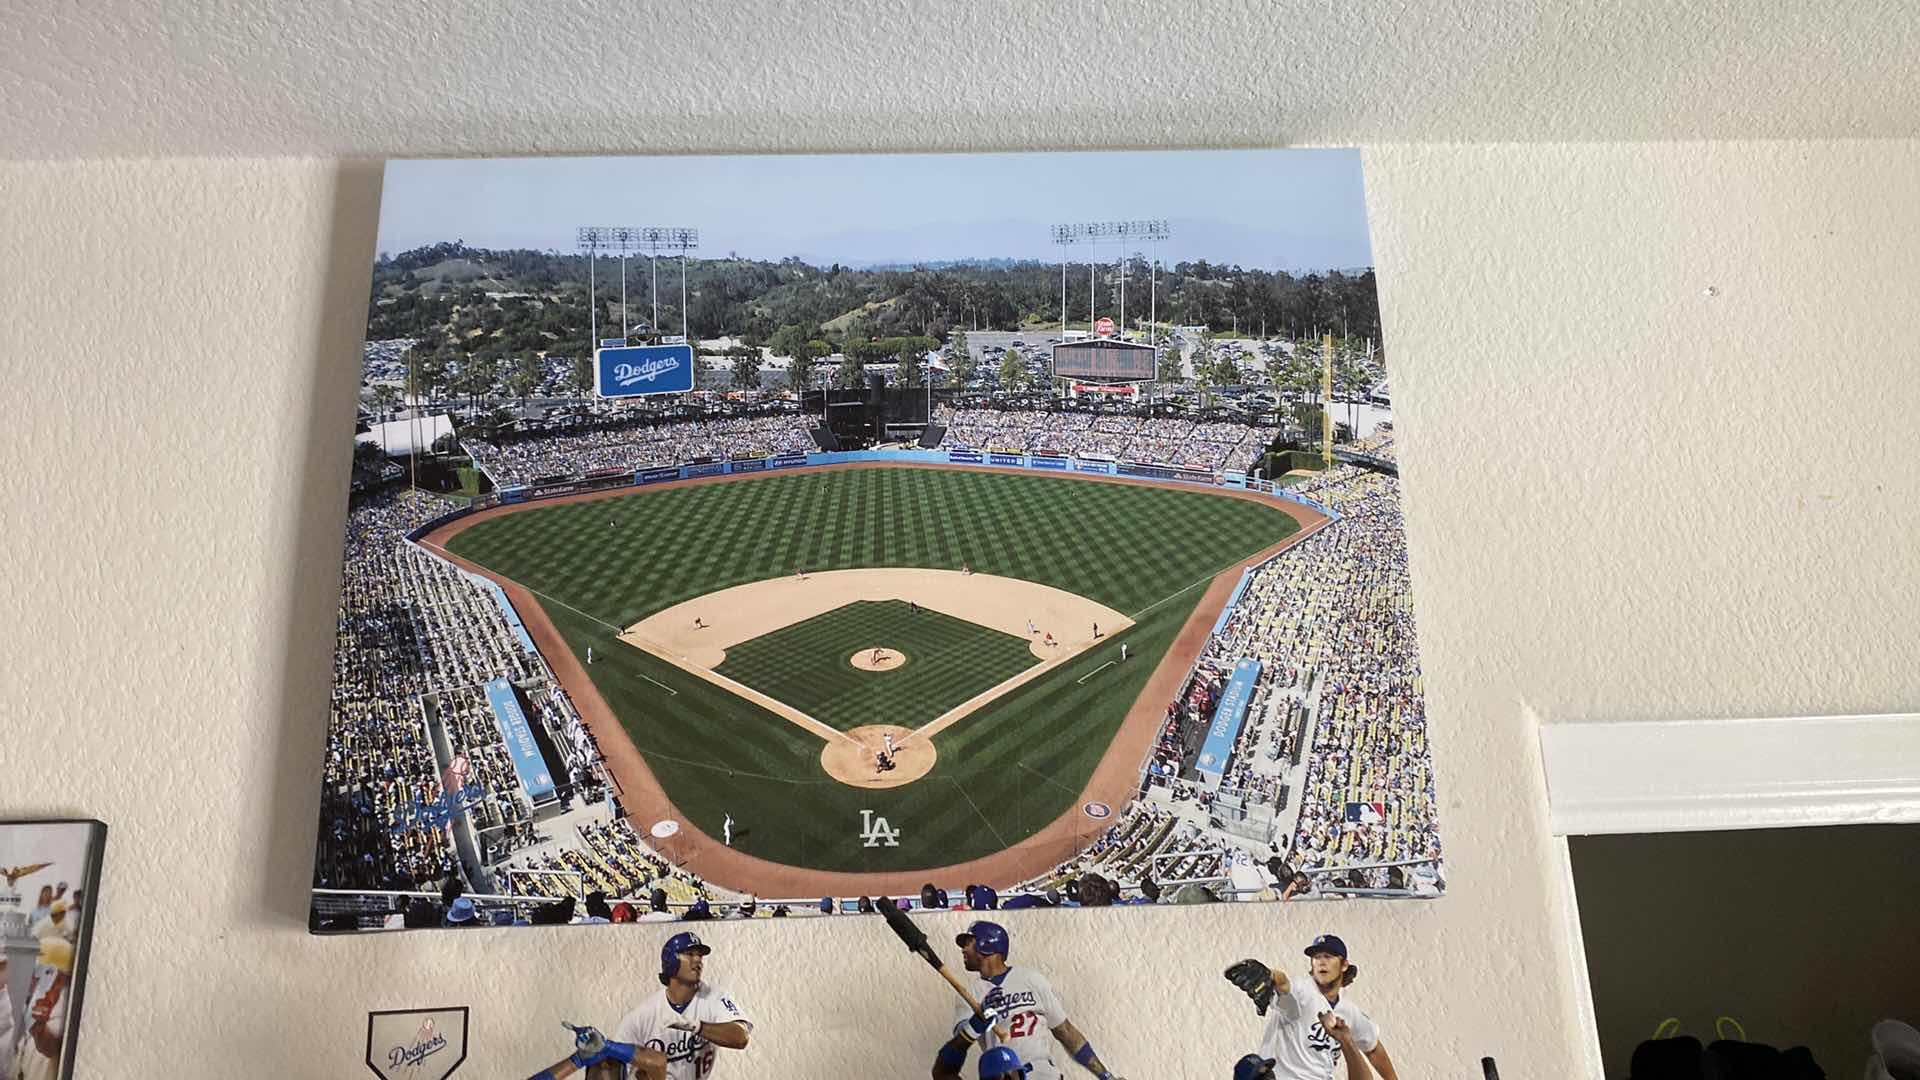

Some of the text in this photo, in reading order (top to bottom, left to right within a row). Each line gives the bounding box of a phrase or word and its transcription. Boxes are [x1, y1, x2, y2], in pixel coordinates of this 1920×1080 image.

[614, 356, 680, 386] Dodgers
[991, 456, 1016, 465] UNITED
[1213, 707, 1232, 738] DODGER
[859, 810, 900, 847] LA
[1010, 1011, 1038, 1038] 27
[389, 1033, 447, 1069] Dodgers
